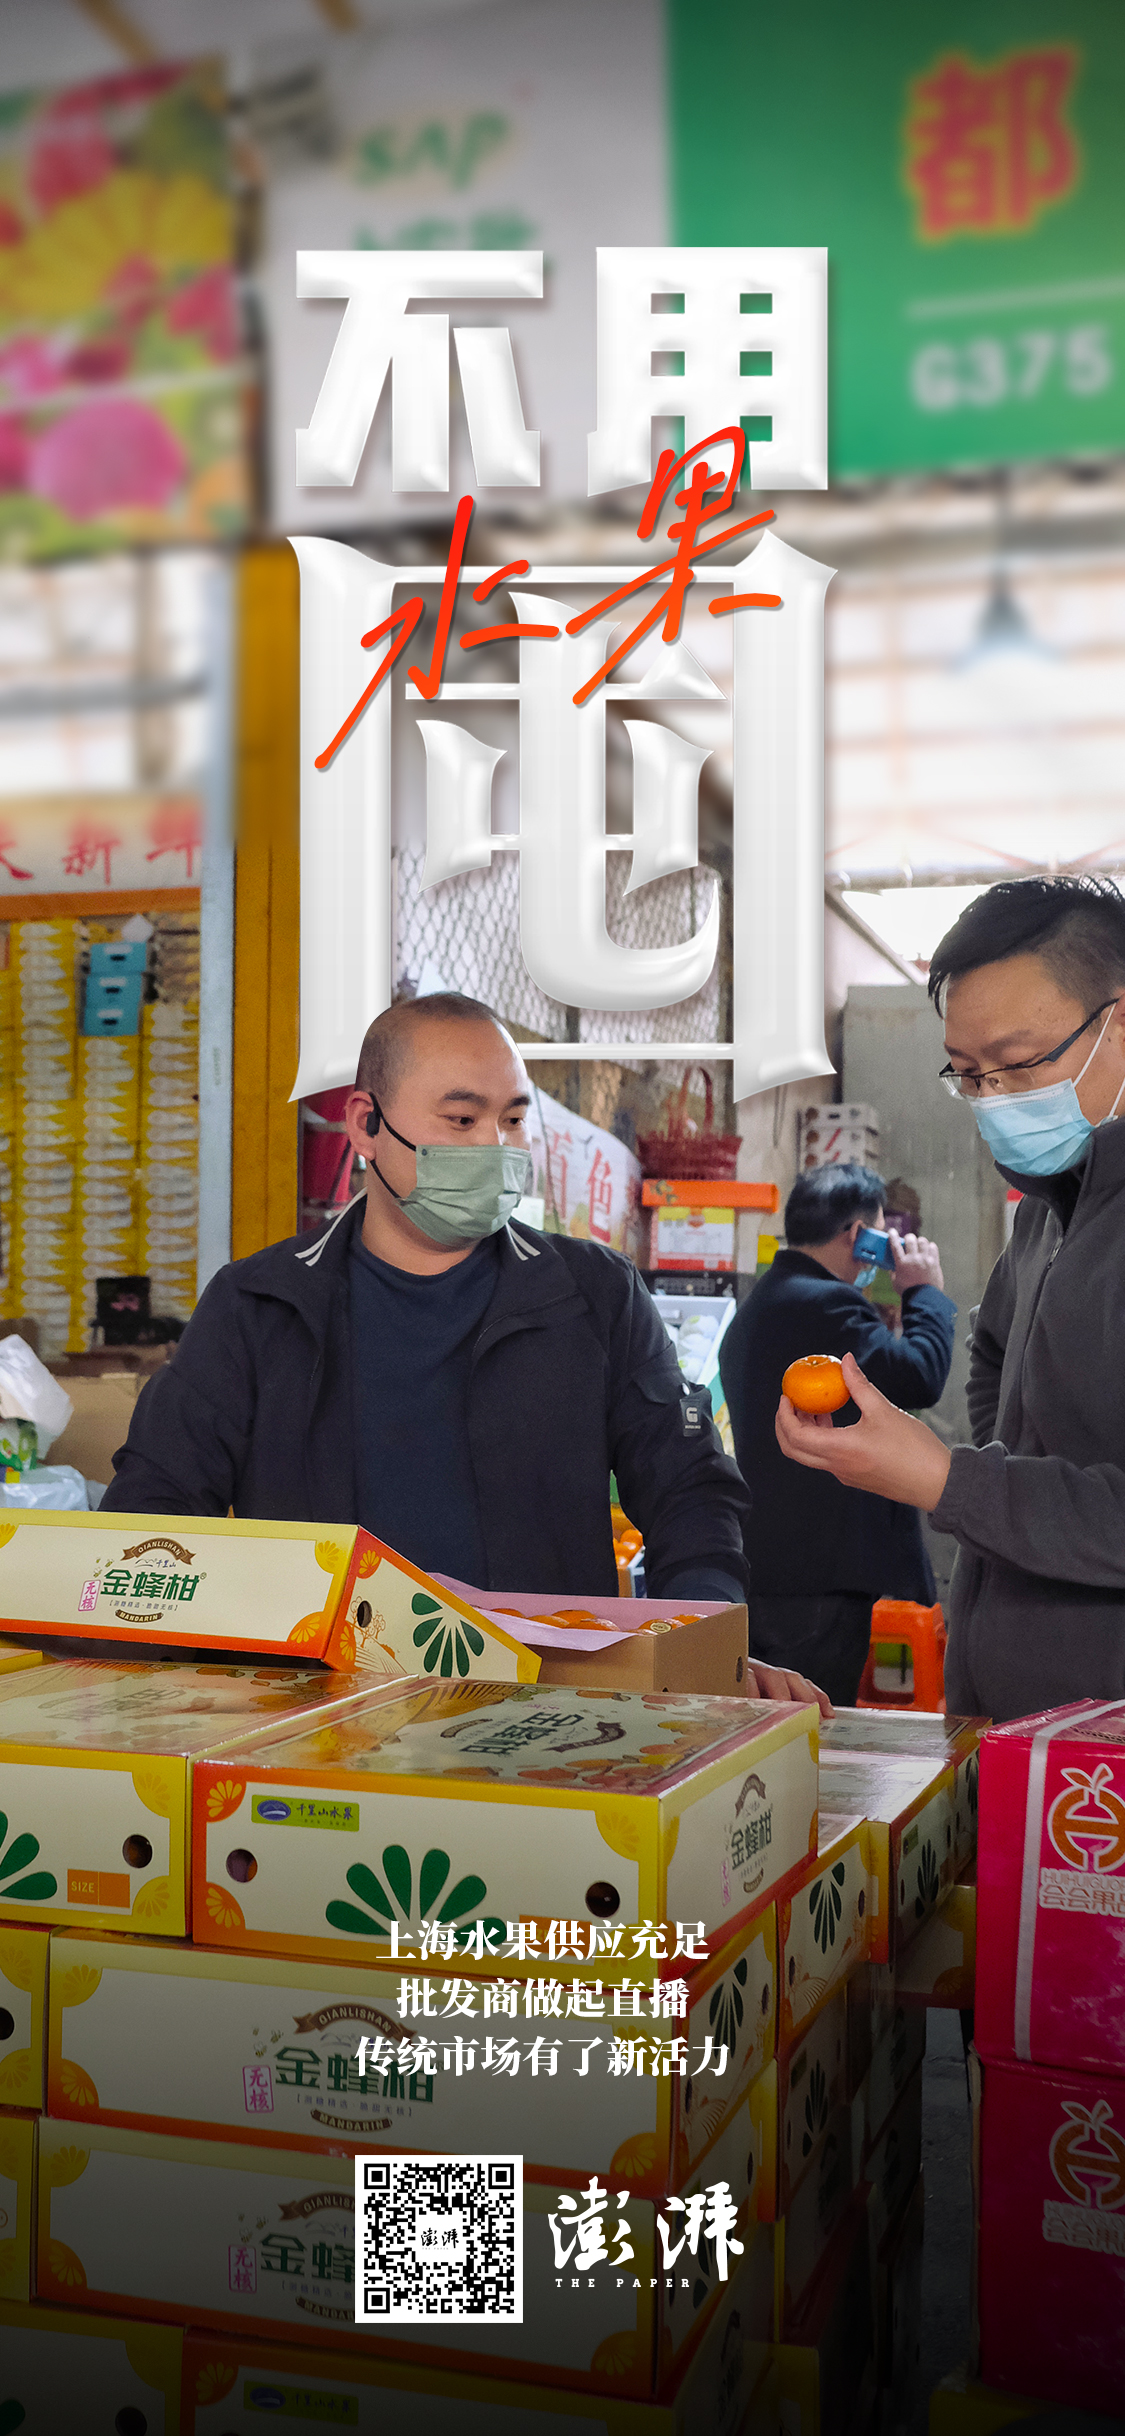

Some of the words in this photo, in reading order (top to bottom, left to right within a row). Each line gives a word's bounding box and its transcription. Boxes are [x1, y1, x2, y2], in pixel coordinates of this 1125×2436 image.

[138, 1540, 181, 1557] QIANLISHAN
[81, 1581, 96, 1609] 无核
[100, 1568, 200, 1602] 金蜂柑
[119, 1610, 159, 1622] MANDARIN
[71, 1880, 95, 1893] SIZE
[318, 2006, 393, 2034] QIANLISHAN
[249, 2066, 270, 2111] 无核
[318, 2112, 386, 2132] MANDARIN
[234, 2246, 253, 2292] 无核
